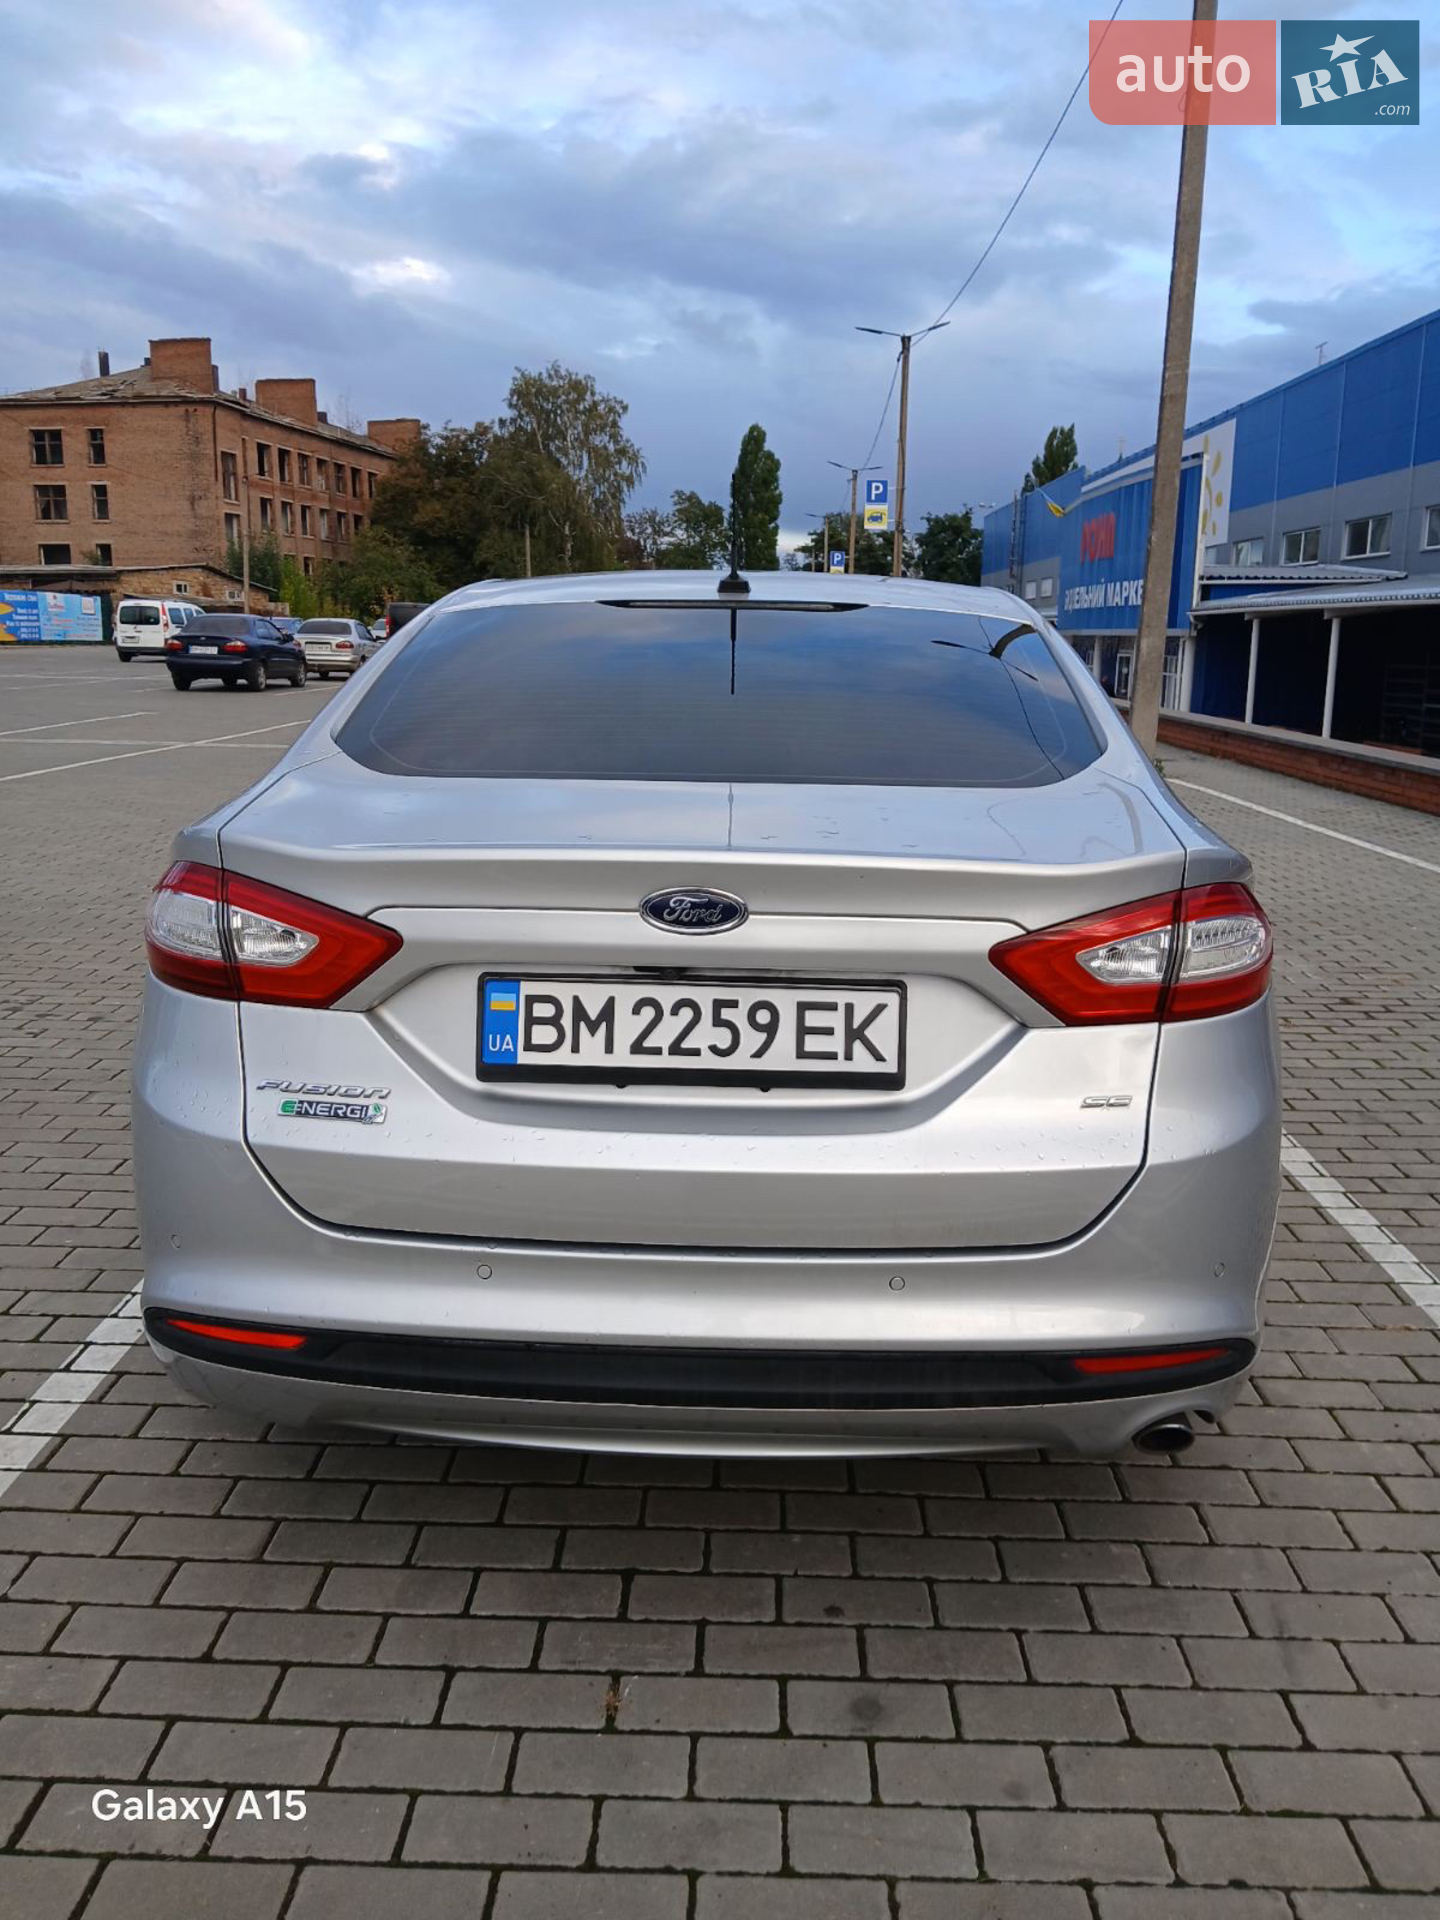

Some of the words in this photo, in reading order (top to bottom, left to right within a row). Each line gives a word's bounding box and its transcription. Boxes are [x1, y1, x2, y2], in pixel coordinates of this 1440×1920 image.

[871, 482, 883, 500] P
[834, 552, 842, 564] P
[1106, 579, 1144, 607] МАРКЕ
[663, 896, 723, 922] Ford
[523, 994, 615, 1054] BM
[629, 997, 780, 1059] 2259
[795, 1000, 888, 1062] EK
[488, 1034, 514, 1052] UA
[256, 1079, 391, 1099] FUSION
[1080, 1095, 1133, 1109] SE
